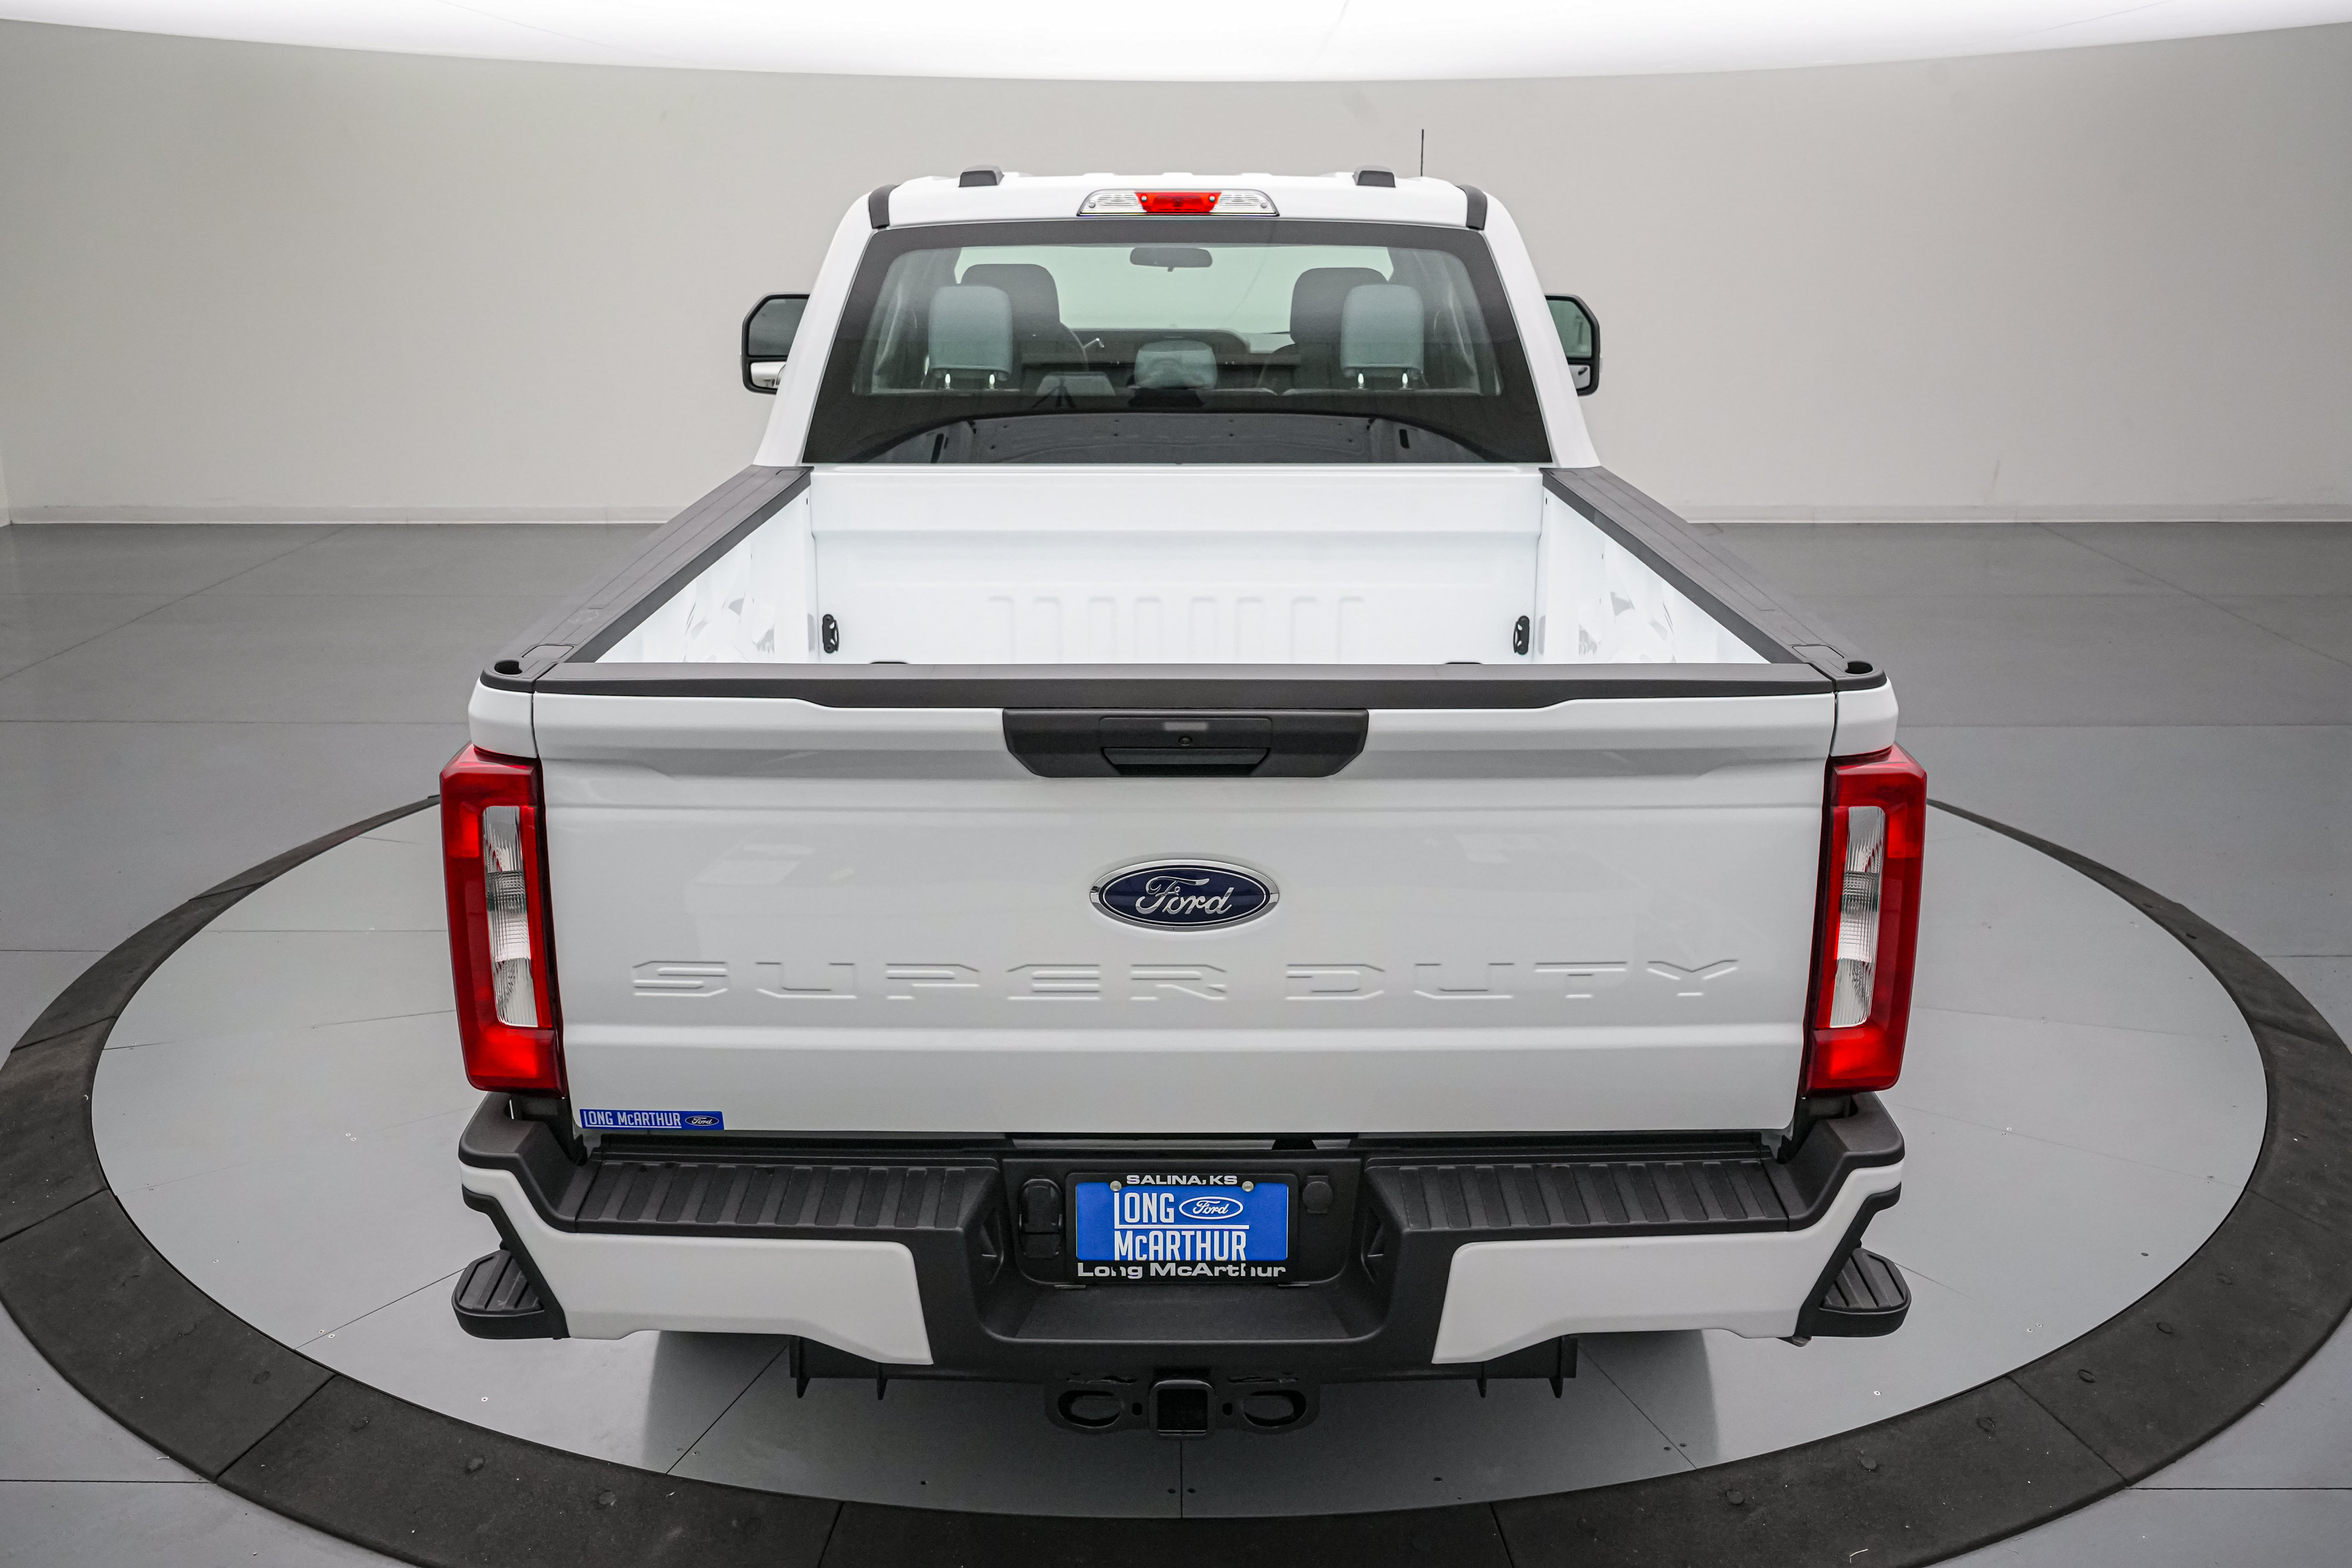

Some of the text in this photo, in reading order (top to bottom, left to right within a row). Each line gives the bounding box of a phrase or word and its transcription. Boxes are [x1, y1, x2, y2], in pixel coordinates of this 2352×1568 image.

[1135, 875, 1234, 914] Ford
[632, 959, 1739, 1001] SUPER DUTY
[583, 1111, 681, 1126] LONG McARTHUR
[691, 1116, 713, 1125] Ford
[1210, 1175, 1238, 1185] KS
[1114, 1193, 1175, 1229] LONG
[1192, 1200, 1229, 1215] Ford
[1114, 1231, 1247, 1261] McARTHUR
[1077, 1262, 1286, 1279] Long McArthur
